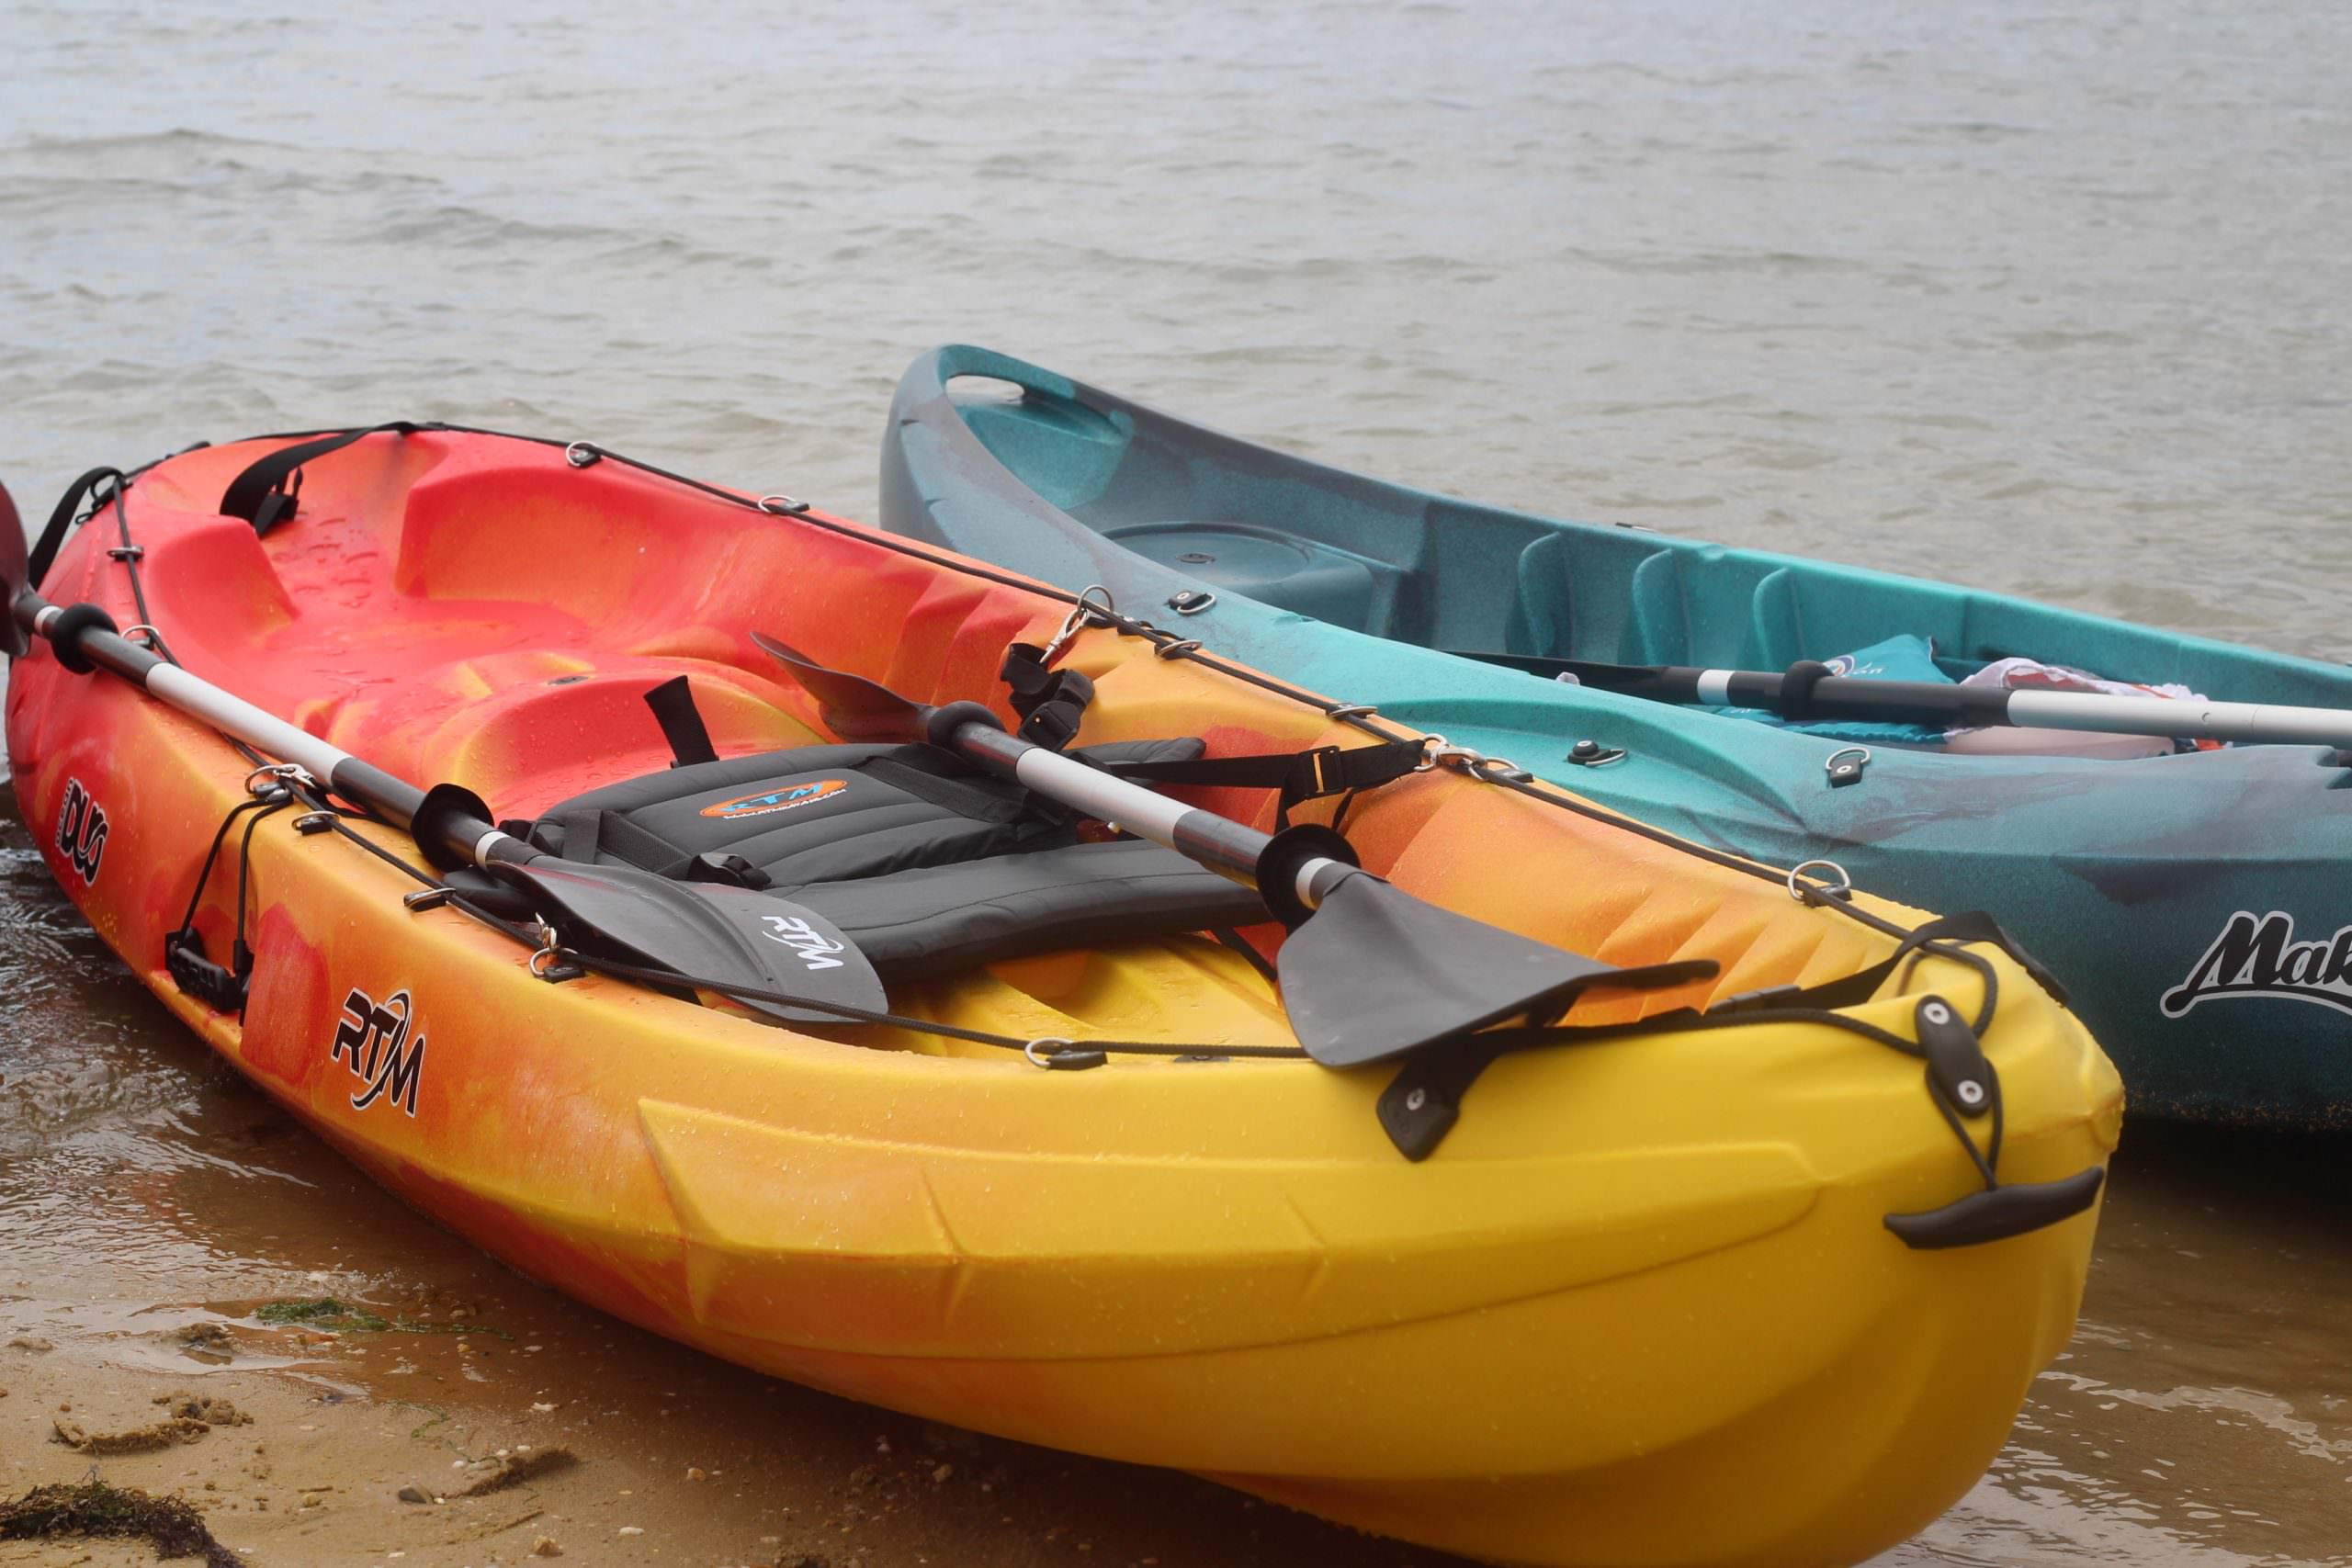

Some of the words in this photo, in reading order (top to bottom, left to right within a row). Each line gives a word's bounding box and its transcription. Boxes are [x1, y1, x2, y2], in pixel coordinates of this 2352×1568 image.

[720, 783, 824, 812] RTM
[762, 916, 844, 970] RTM
[331, 987, 426, 1118] RTM
